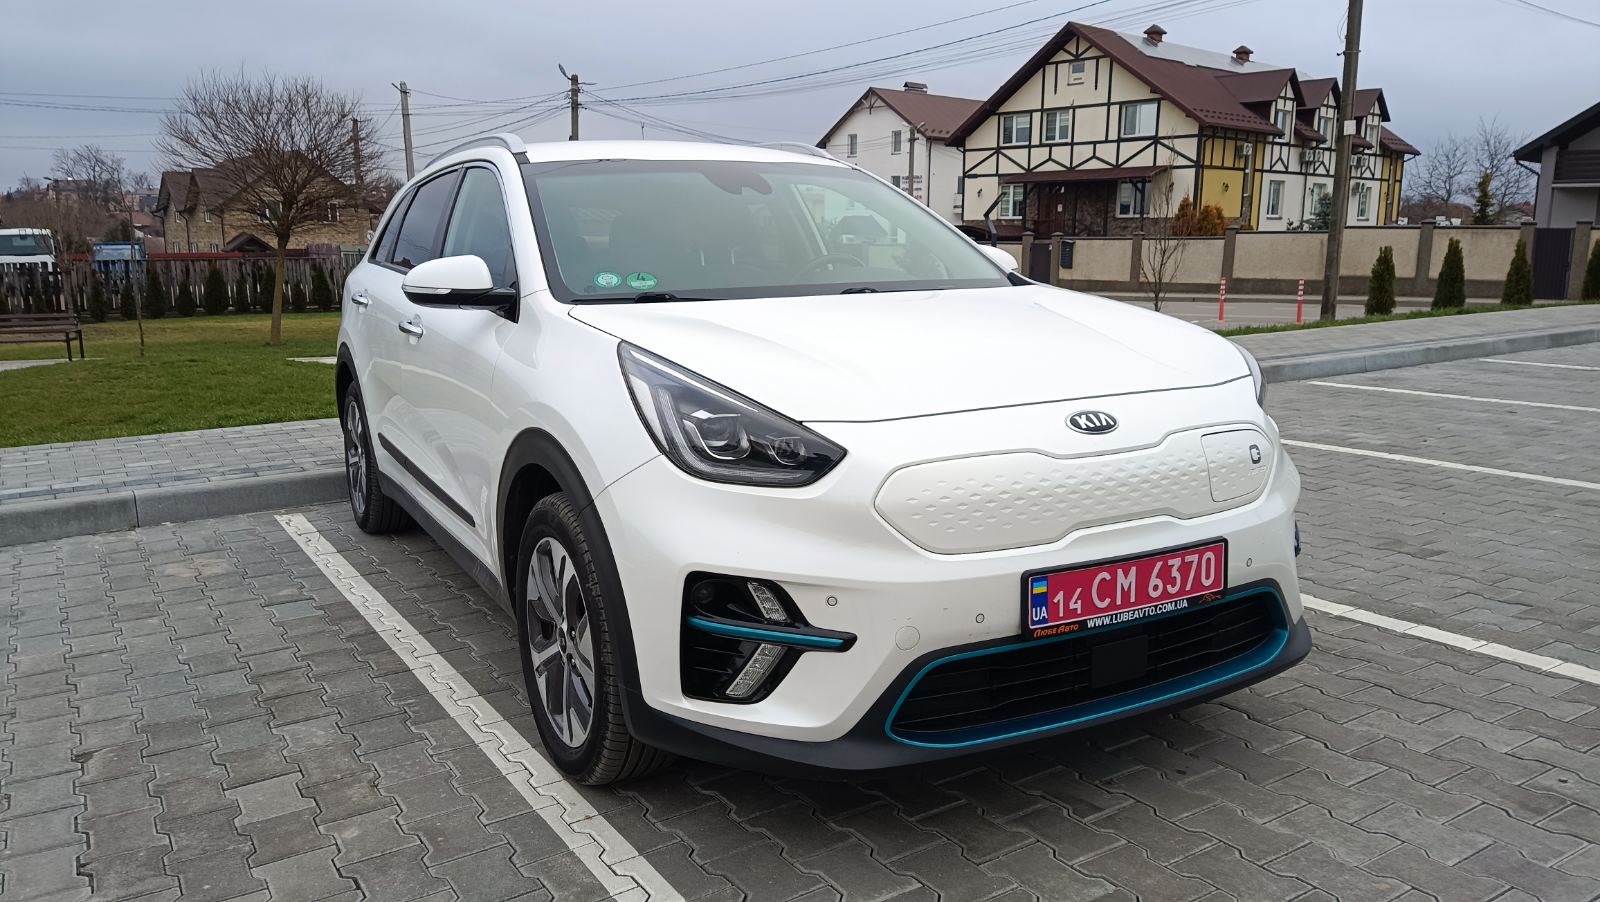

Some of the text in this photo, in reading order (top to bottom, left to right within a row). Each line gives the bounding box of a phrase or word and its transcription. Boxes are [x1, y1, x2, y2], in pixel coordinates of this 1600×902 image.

[1073, 412, 1115, 429] KIA
[1053, 551, 1216, 617] 14 CM 6370
[1032, 606, 1048, 622] UA
[1087, 599, 1189, 629] WWW.LUBEAVTO.COM.UA
